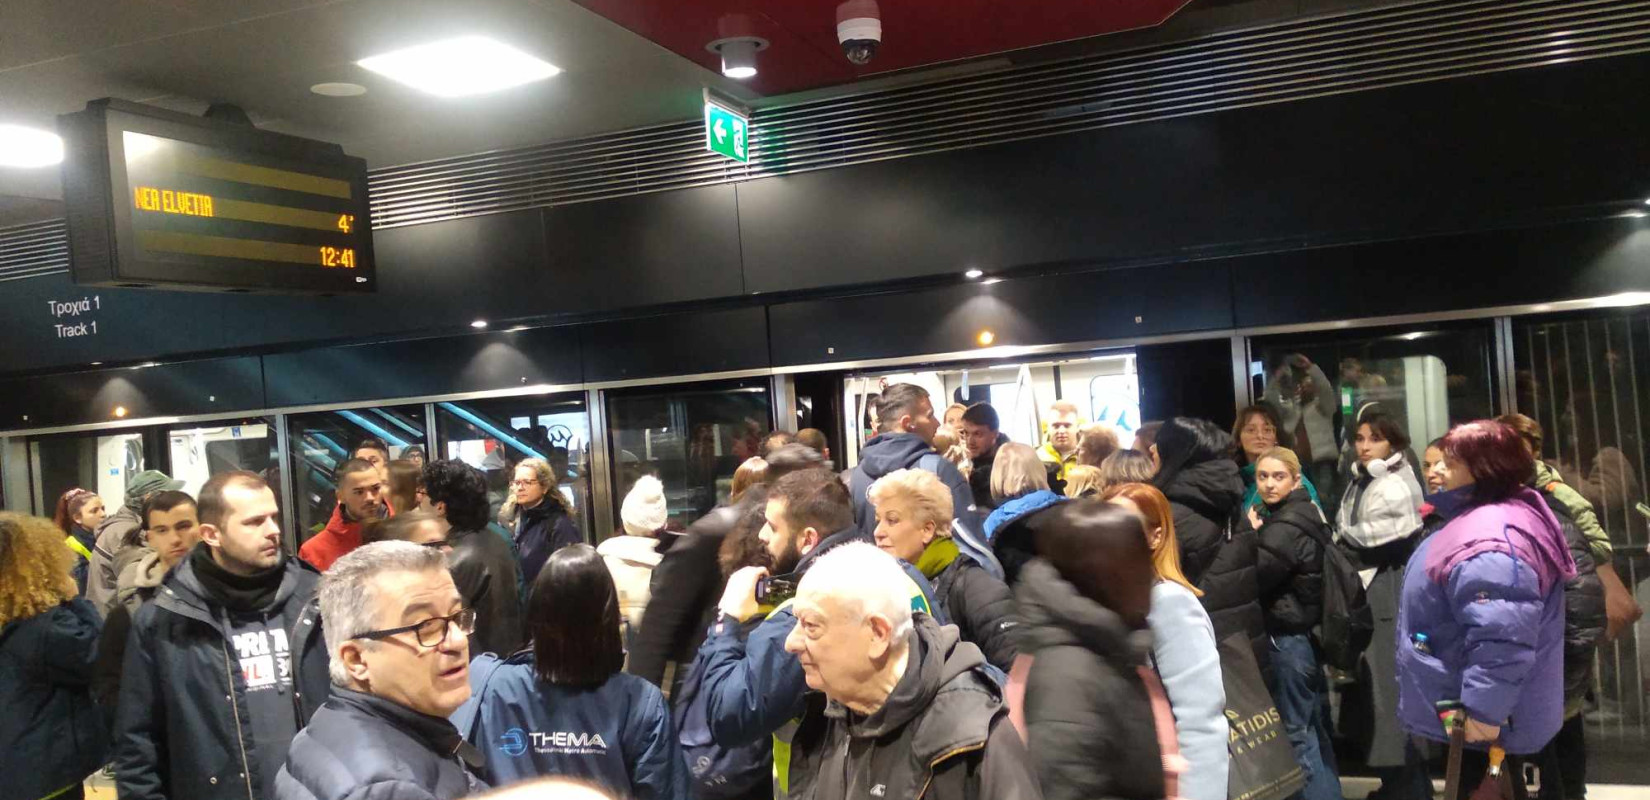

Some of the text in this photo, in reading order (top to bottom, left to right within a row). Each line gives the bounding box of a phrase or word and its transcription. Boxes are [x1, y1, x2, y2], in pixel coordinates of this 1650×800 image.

[134, 186, 213, 217] NEA ELVETIA
[320, 246, 355, 268] 12:41
[47, 295, 100, 318] Τροχιά 1
[54, 320, 97, 338] Track 1
[1228, 707, 1280, 744] ATIDIS
[529, 731, 607, 748] THEMA
